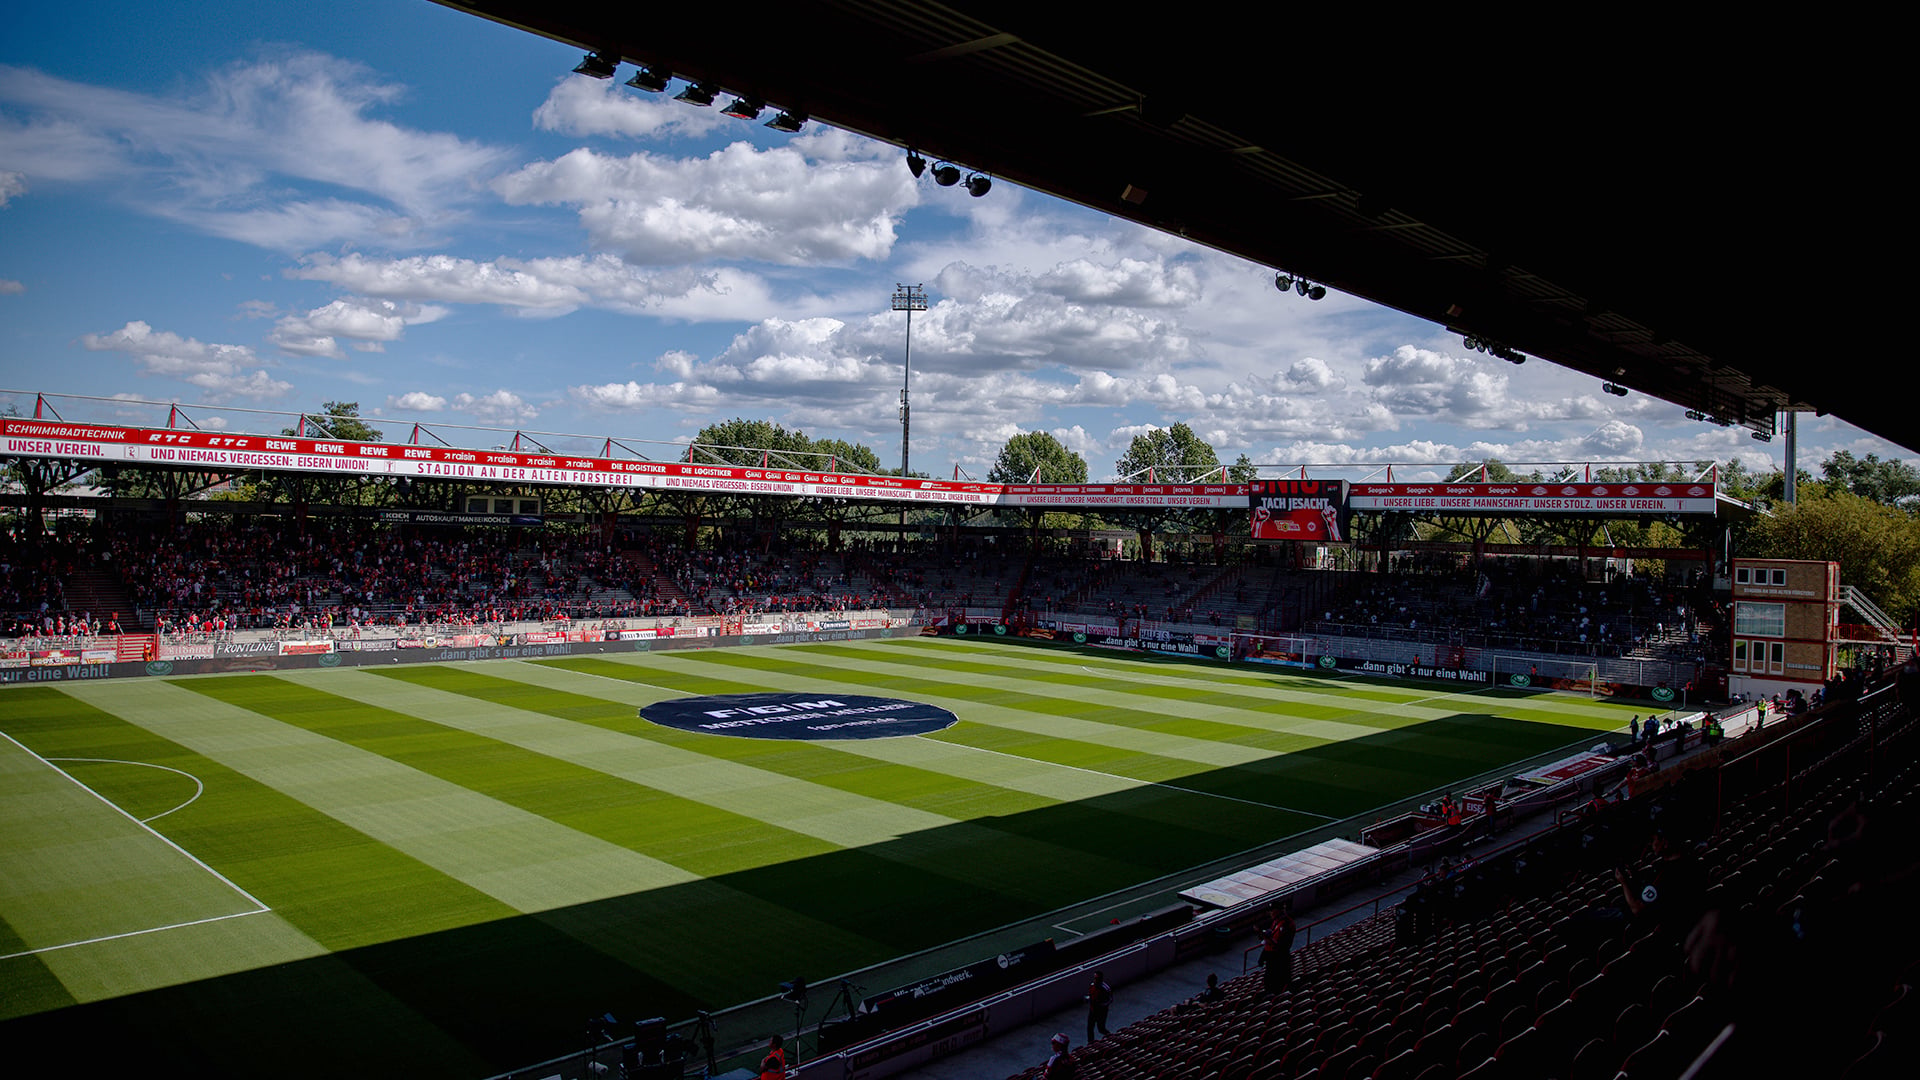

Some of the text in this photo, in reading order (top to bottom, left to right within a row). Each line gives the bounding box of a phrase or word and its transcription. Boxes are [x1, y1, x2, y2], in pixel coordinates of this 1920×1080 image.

[7, 424, 126, 440] SCHWIMMBADTECHNIK
[149, 433, 248, 447] RTC RTC
[266, 440, 297, 450] REWE
[8, 439, 104, 457] UNSER VEREIN.
[315, 443, 345, 454] REWE
[360, 446, 388, 456] REWE
[404, 448, 431, 458] REWE
[151, 447, 369, 470] UND NIEMALS VERGESSEN: EISERN UNION!
[452, 452, 476, 462] raisin
[494, 455, 517, 465] raisin
[534, 458, 556, 467] raisin
[573, 460, 594, 470] raisin
[611, 462, 667, 475] DIE LOGISTIKER
[418, 462, 474, 476] STADION
[481, 467, 497, 478] AN
[503, 468, 525, 480] DER
[531, 469, 567, 481] ALTEN
[681, 466, 732, 478] DIE LOGISTIKER
[666, 478, 794, 492] UND NIEMALS VERGESSEN: EISERN UNION!
[816, 485, 837, 494] UNSERE
[838, 487, 854, 495] LIEBE.
[856, 487, 877, 496] UNSERE
[877, 489, 912, 499] MANNSCHAFT.
[915, 491, 931, 499] UNSER
[948, 492, 963, 501] UNSER
[1027, 496, 1047, 504] UNSERE
[1065, 496, 1085, 504] UNSERE
[1126, 497, 1144, 505] UNSER
[1167, 497, 1188, 505] UNSER
[1189, 497, 1212, 506] VEREIN.
[1260, 497, 1330, 511] TACH JESACHT
[1383, 498, 1666, 510] UNSERE LIEBE. UNSERE MANNSCHAFT. UNSER STOLZ. UNSER VEREIN.
[832, 632, 847, 640] eine
[216, 642, 276, 655] FRONTLINE
[430, 648, 466, 660] ...dann
[503, 648, 520, 658] nur
[522, 646, 546, 656] eine
[545, 644, 571, 655] Wahl!
[1147, 641, 1160, 650] nur
[1161, 641, 1176, 651] eine
[1177, 642, 1199, 653] Wahl!
[27, 667, 62, 681] eine
[67, 664, 110, 679] Wahl!
[1354, 661, 1385, 672] ...dann
[1417, 667, 1434, 677] nur
[1435, 669, 1456, 680] eine
[1458, 669, 1486, 682] Wahl!
